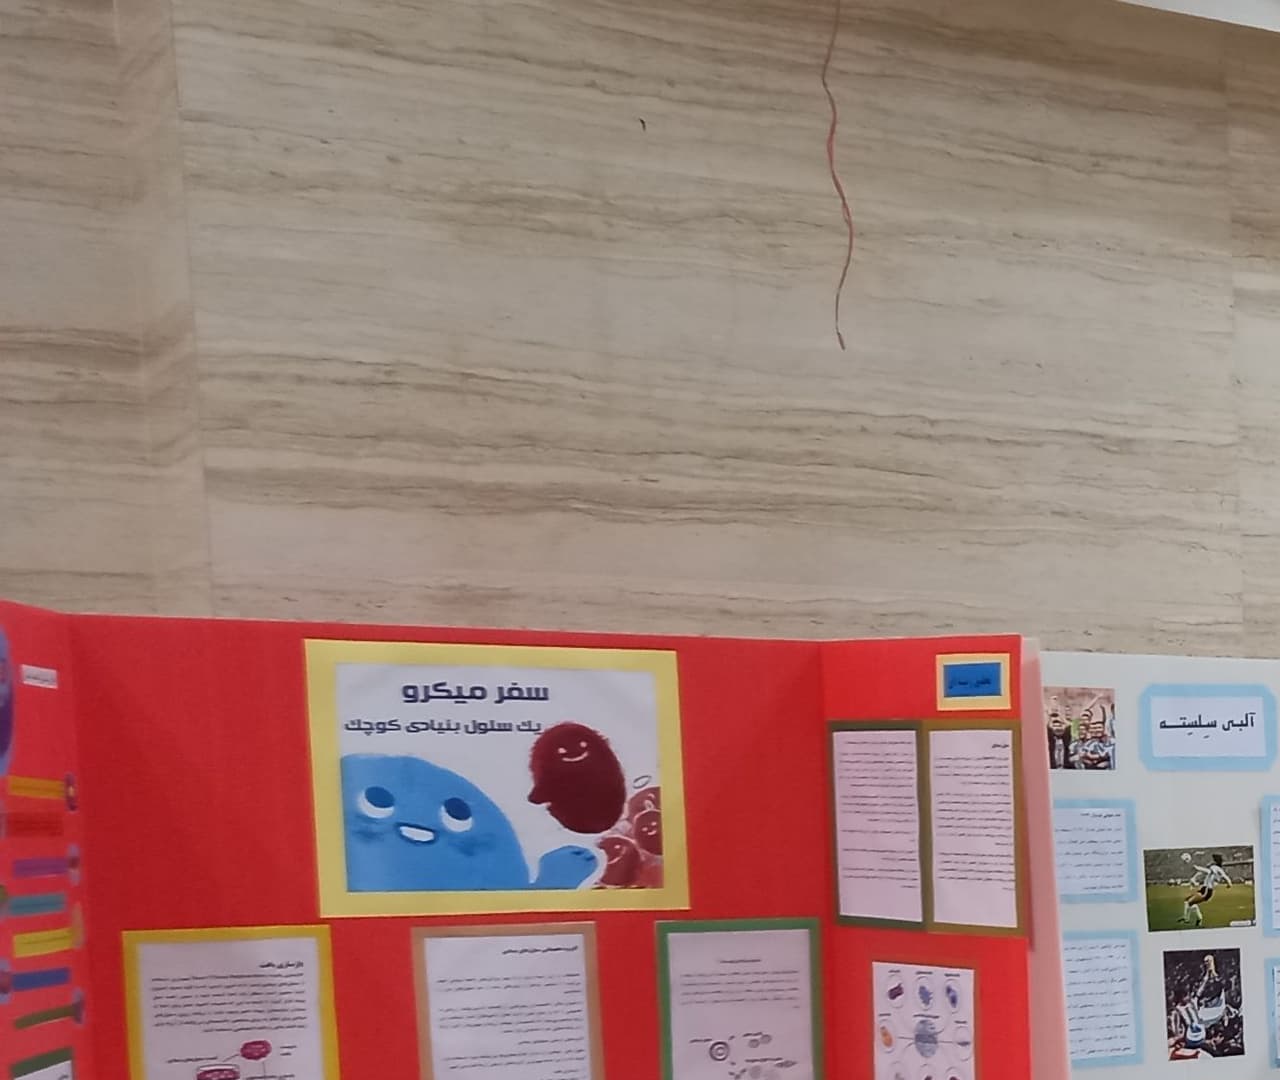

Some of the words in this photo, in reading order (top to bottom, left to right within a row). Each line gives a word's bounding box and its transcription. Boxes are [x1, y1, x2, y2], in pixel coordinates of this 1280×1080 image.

[401, 681, 488, 704] میکرو
[493, 681, 550, 704] سفر
[404, 719, 461, 735] بنیادی
[463, 719, 513, 735] سلول
[1222, 711, 1257, 732] آلبی
